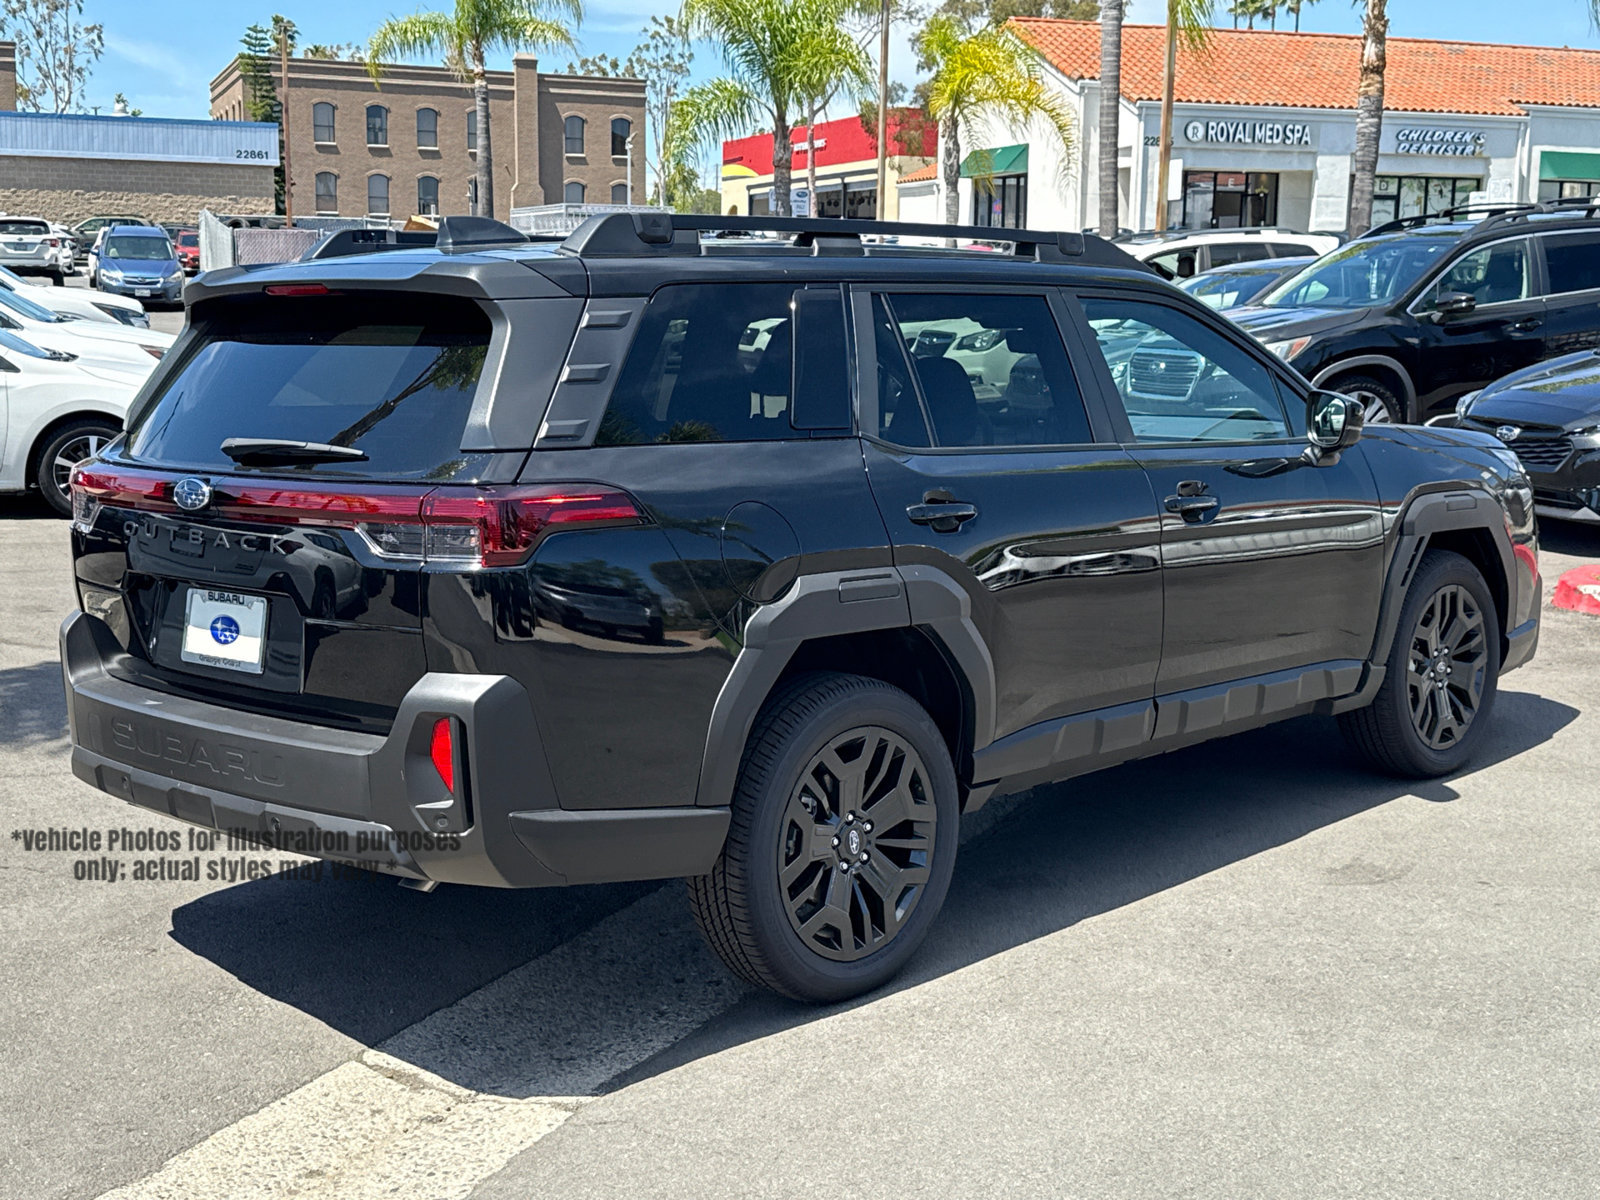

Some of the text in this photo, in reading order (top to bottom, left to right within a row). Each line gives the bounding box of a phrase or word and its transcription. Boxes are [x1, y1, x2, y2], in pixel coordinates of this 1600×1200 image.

[1206, 121, 1252, 143] ROYAL
[1253, 122, 1283, 144] MED
[1284, 124, 1312, 146] SPA
[1396, 129, 1487, 144] CHILDREN'S
[236, 149, 269, 160] 22861
[1396, 143, 1485, 156] DENTISTRY
[123, 520, 287, 555] OUTBACK
[207, 591, 245, 605] SUBARU
[111, 717, 286, 787] SUBARU
